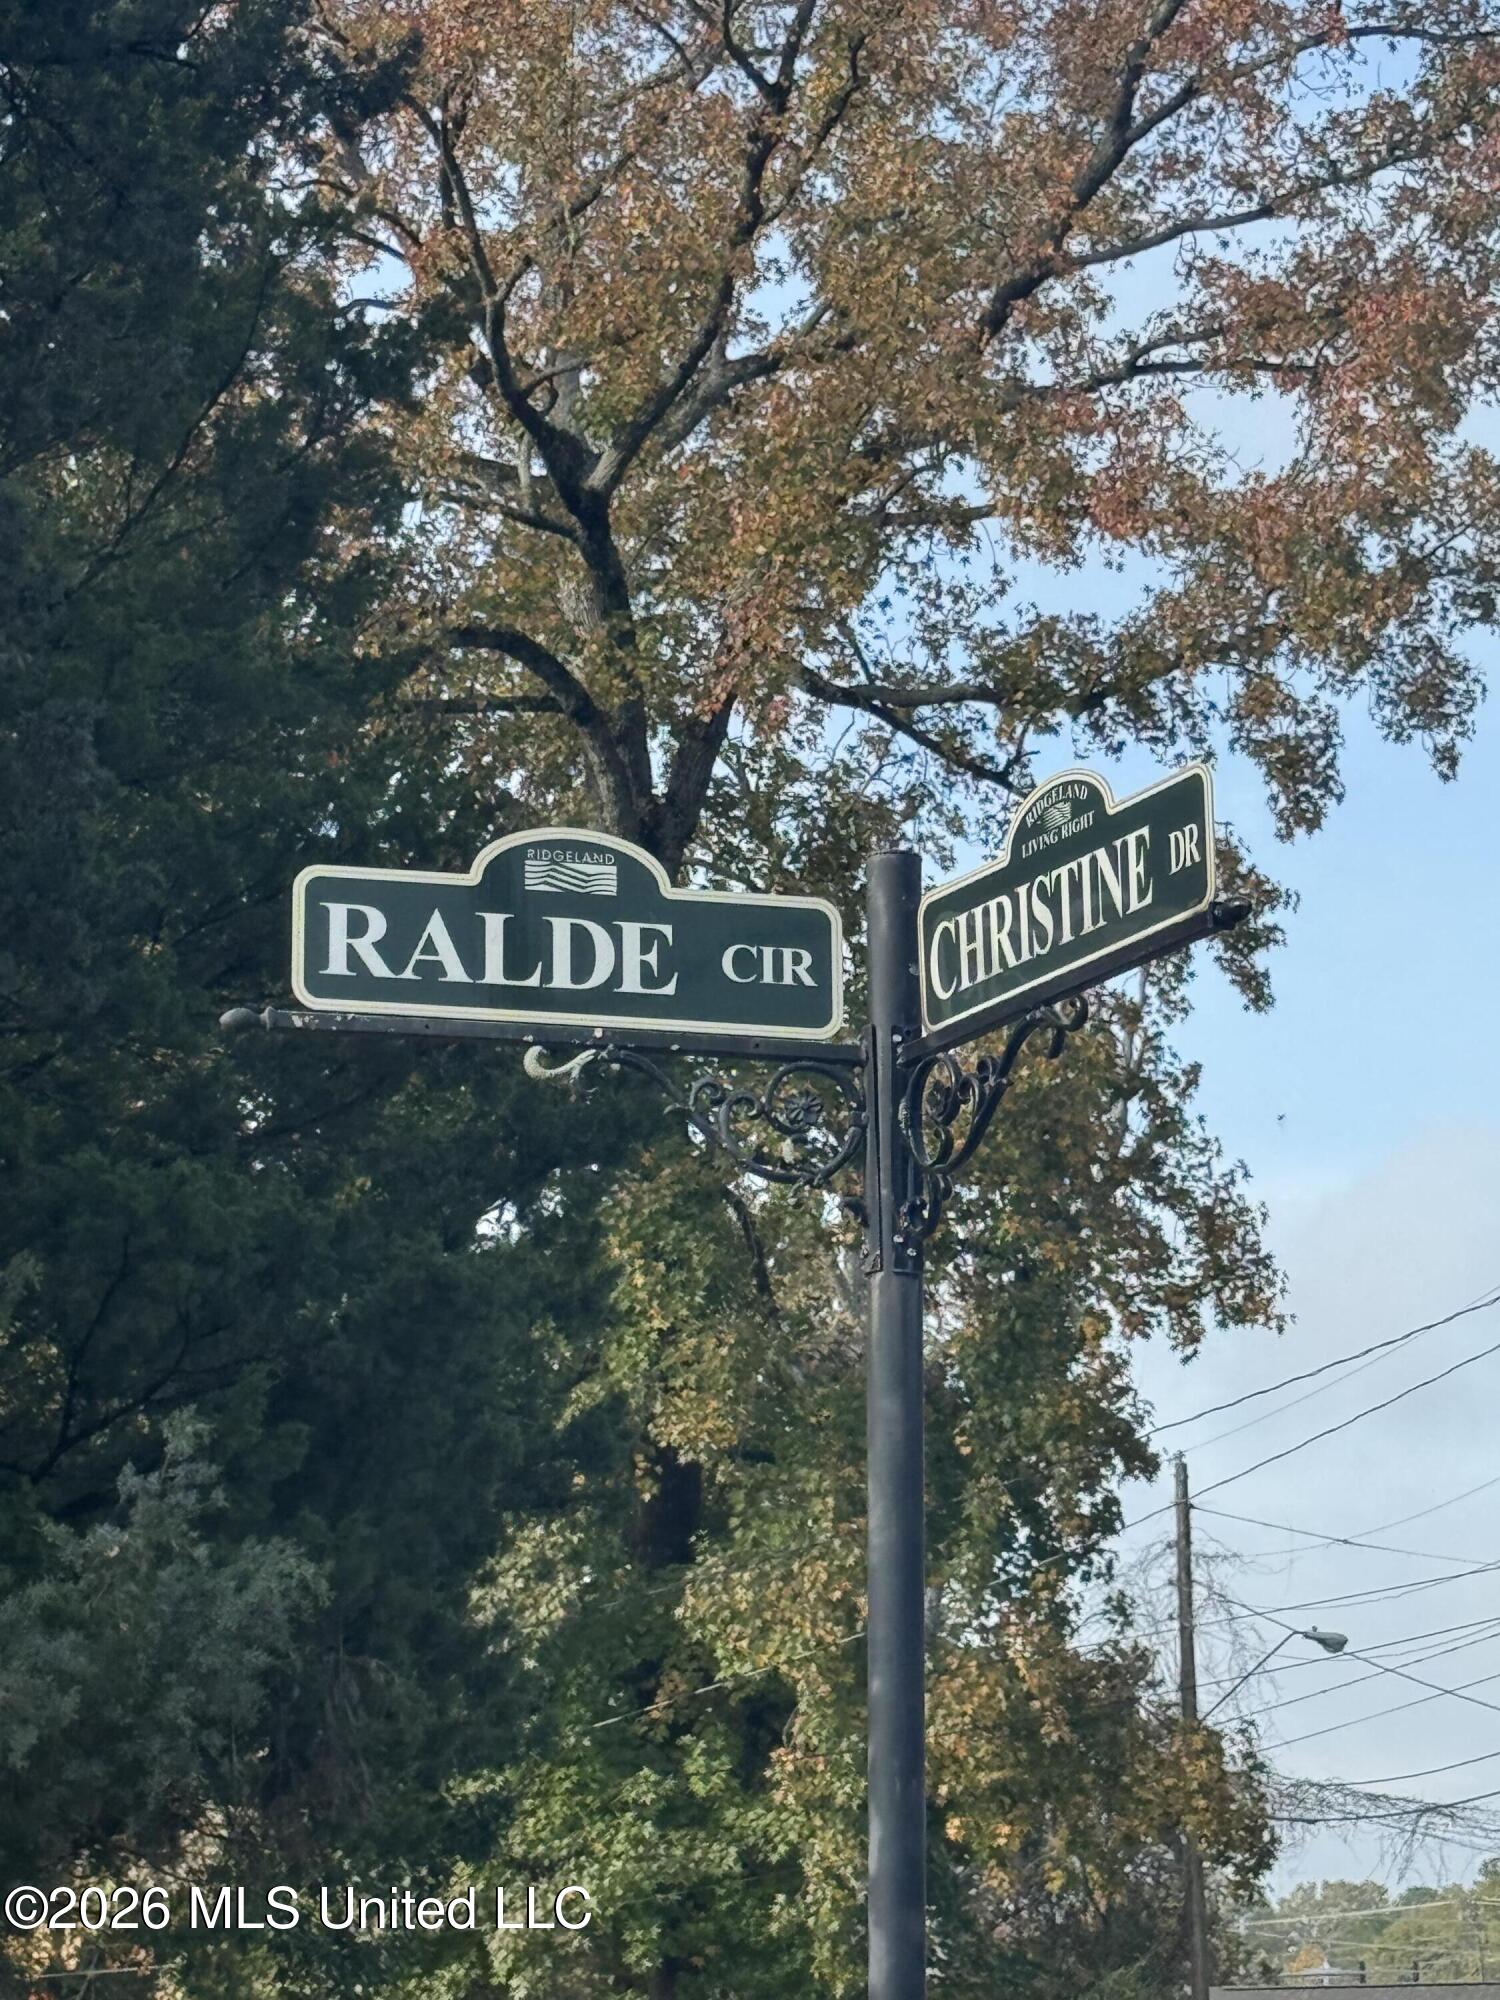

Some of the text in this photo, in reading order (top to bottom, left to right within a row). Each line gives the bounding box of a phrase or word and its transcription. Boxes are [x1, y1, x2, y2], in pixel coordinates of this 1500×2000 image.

[1025, 784, 1088, 827] RIDGELAND
[527, 849, 615, 865] RIDGELAND
[1021, 810, 1095, 858] LIVING RIGHT
[930, 823, 1201, 1000] CHRISTINE DR
[318, 902, 819, 996] RALDE CIR
